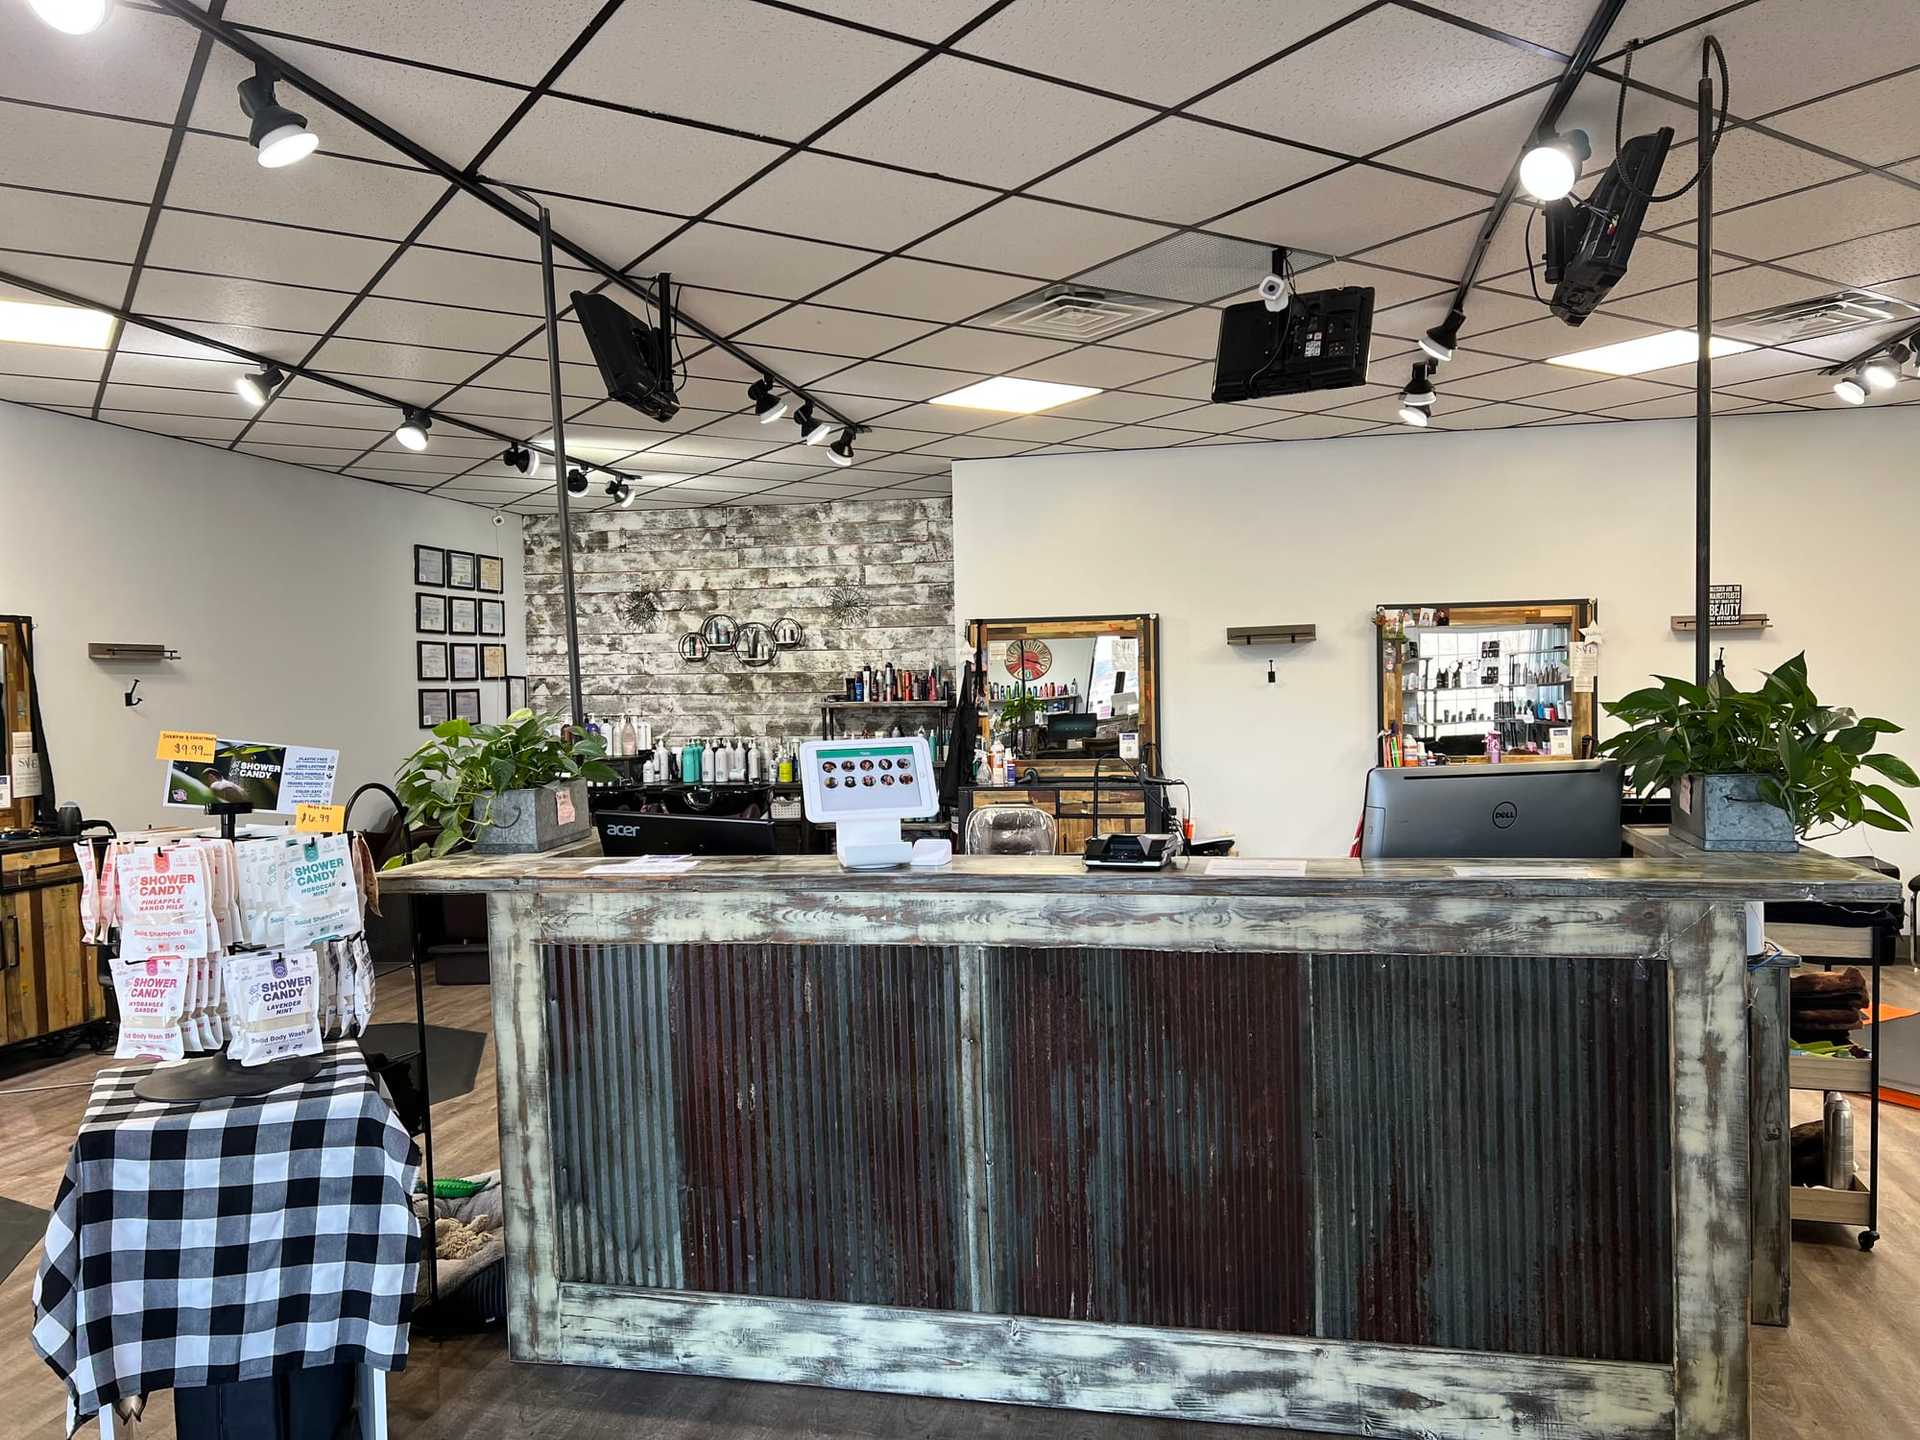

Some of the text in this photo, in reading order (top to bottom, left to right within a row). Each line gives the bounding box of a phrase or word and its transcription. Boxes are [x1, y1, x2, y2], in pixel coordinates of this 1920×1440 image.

[1709, 603, 1740, 616] BEAUTY
[240, 762, 281, 773] SHOWER
[239, 770, 272, 780] CANDY
[1495, 811, 1515, 819] DELL
[606, 824, 641, 837] acer
[294, 858, 345, 876] SHOWER
[140, 874, 196, 886] SHOWER
[296, 870, 337, 886] CANDY
[139, 885, 185, 896] CANDY
[301, 882, 336, 894] MOROCCAN
[312, 889, 329, 897] MINT
[312, 911, 340, 922] Shampoo
[148, 930, 181, 938] Shampoo
[183, 928, 197, 936] Bar
[133, 978, 177, 988] SHOWER
[261, 976, 312, 993] SHOWER
[130, 988, 166, 998] CANDY
[262, 988, 304, 1002] CANDY
[266, 1000, 302, 1011] LAVENDER
[132, 1032, 147, 1040] Body
[269, 1034, 287, 1042] Body
[288, 1030, 306, 1039] Wash
